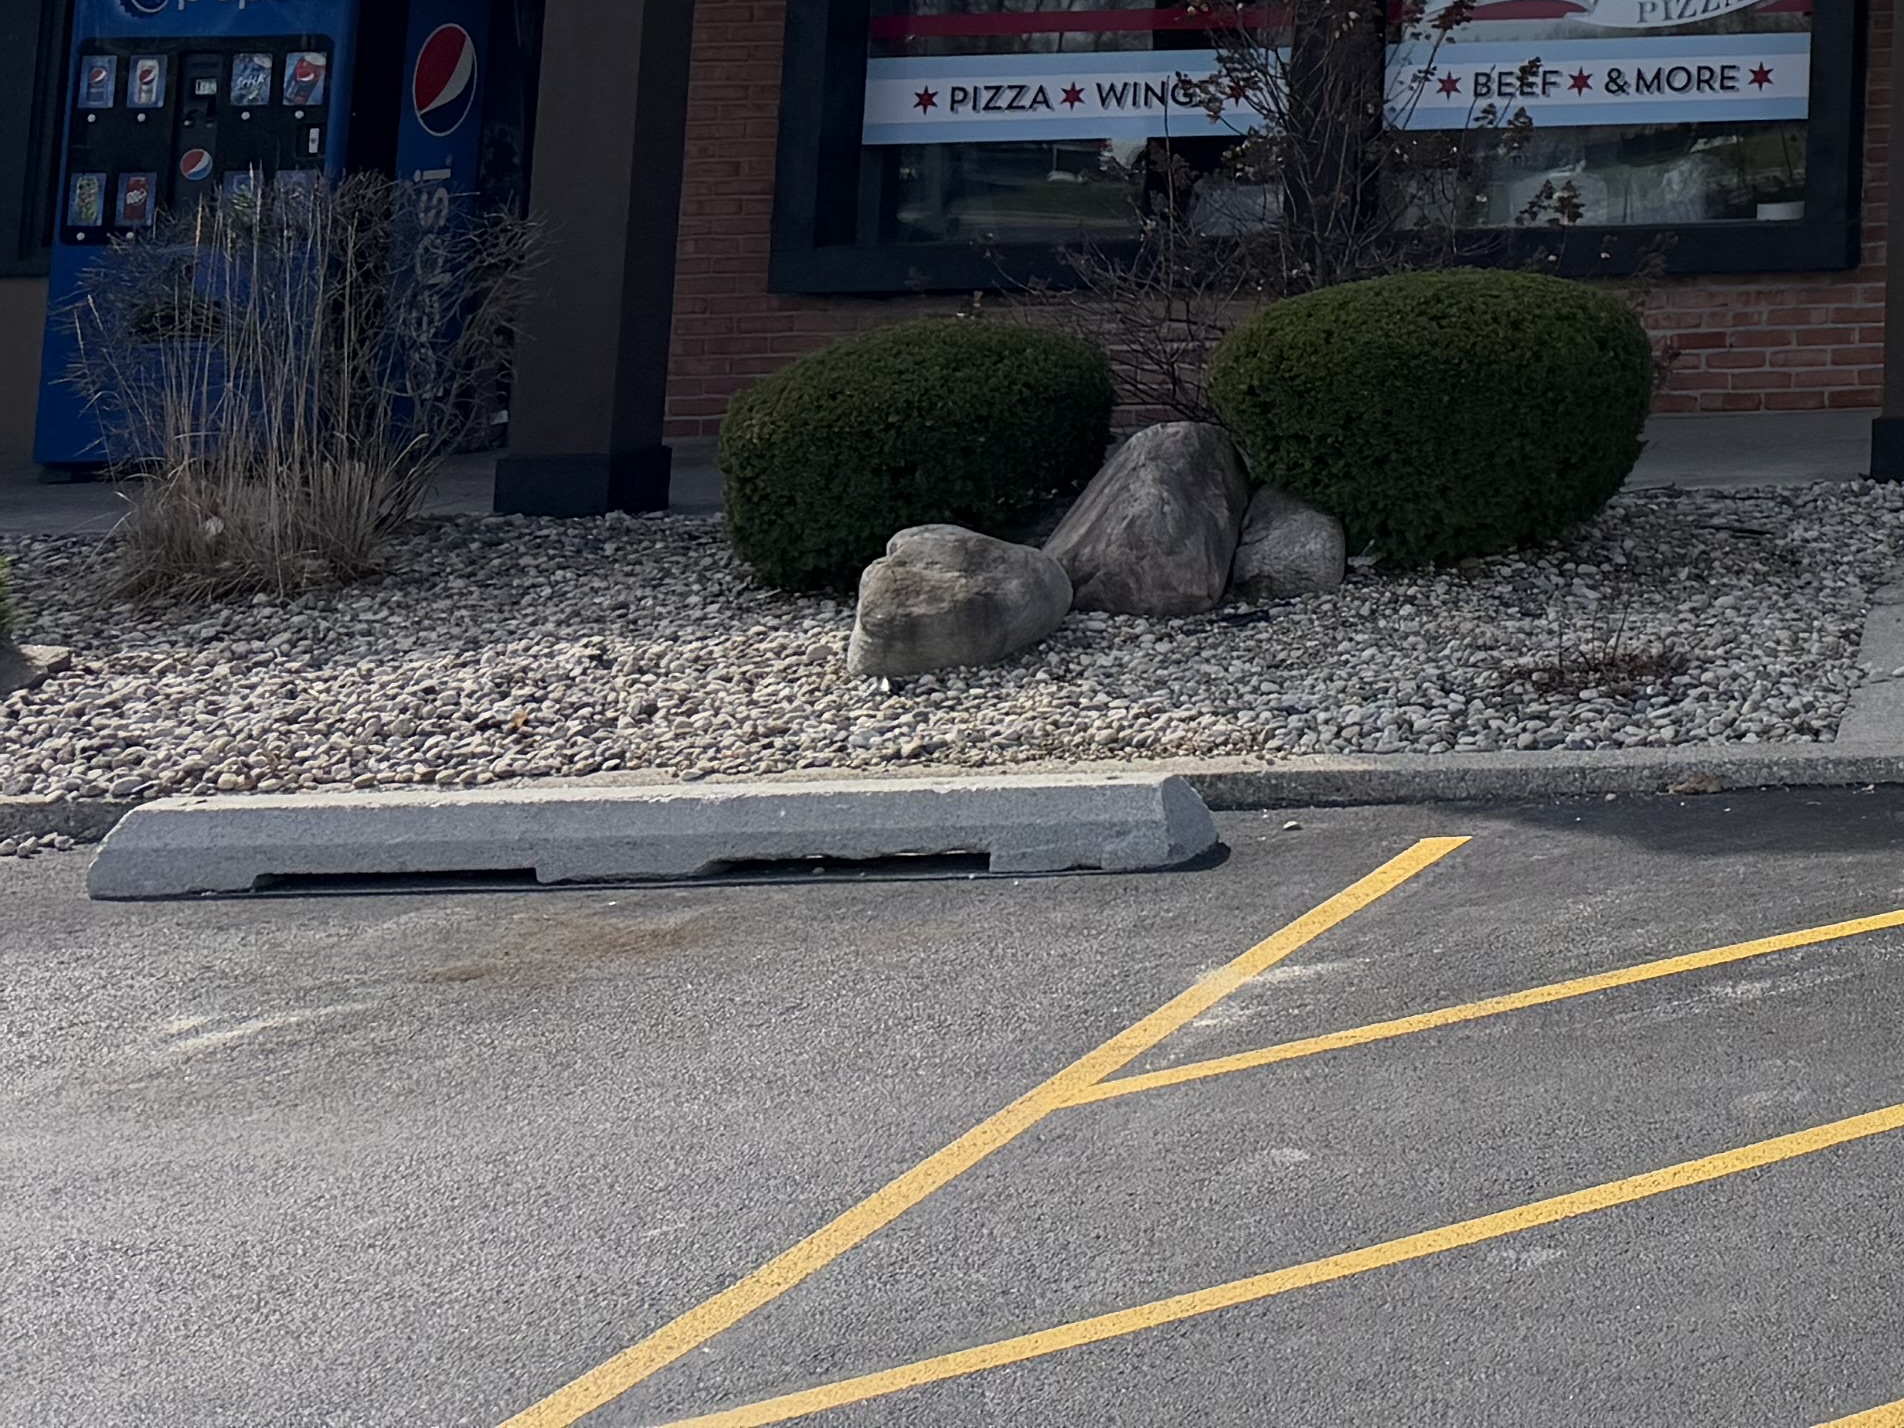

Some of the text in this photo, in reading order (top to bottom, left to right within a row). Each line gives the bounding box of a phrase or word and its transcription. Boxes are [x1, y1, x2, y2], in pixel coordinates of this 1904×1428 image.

[950, 79, 1207, 113] PIZZA WING
[1473, 67, 1564, 99] BEEF
